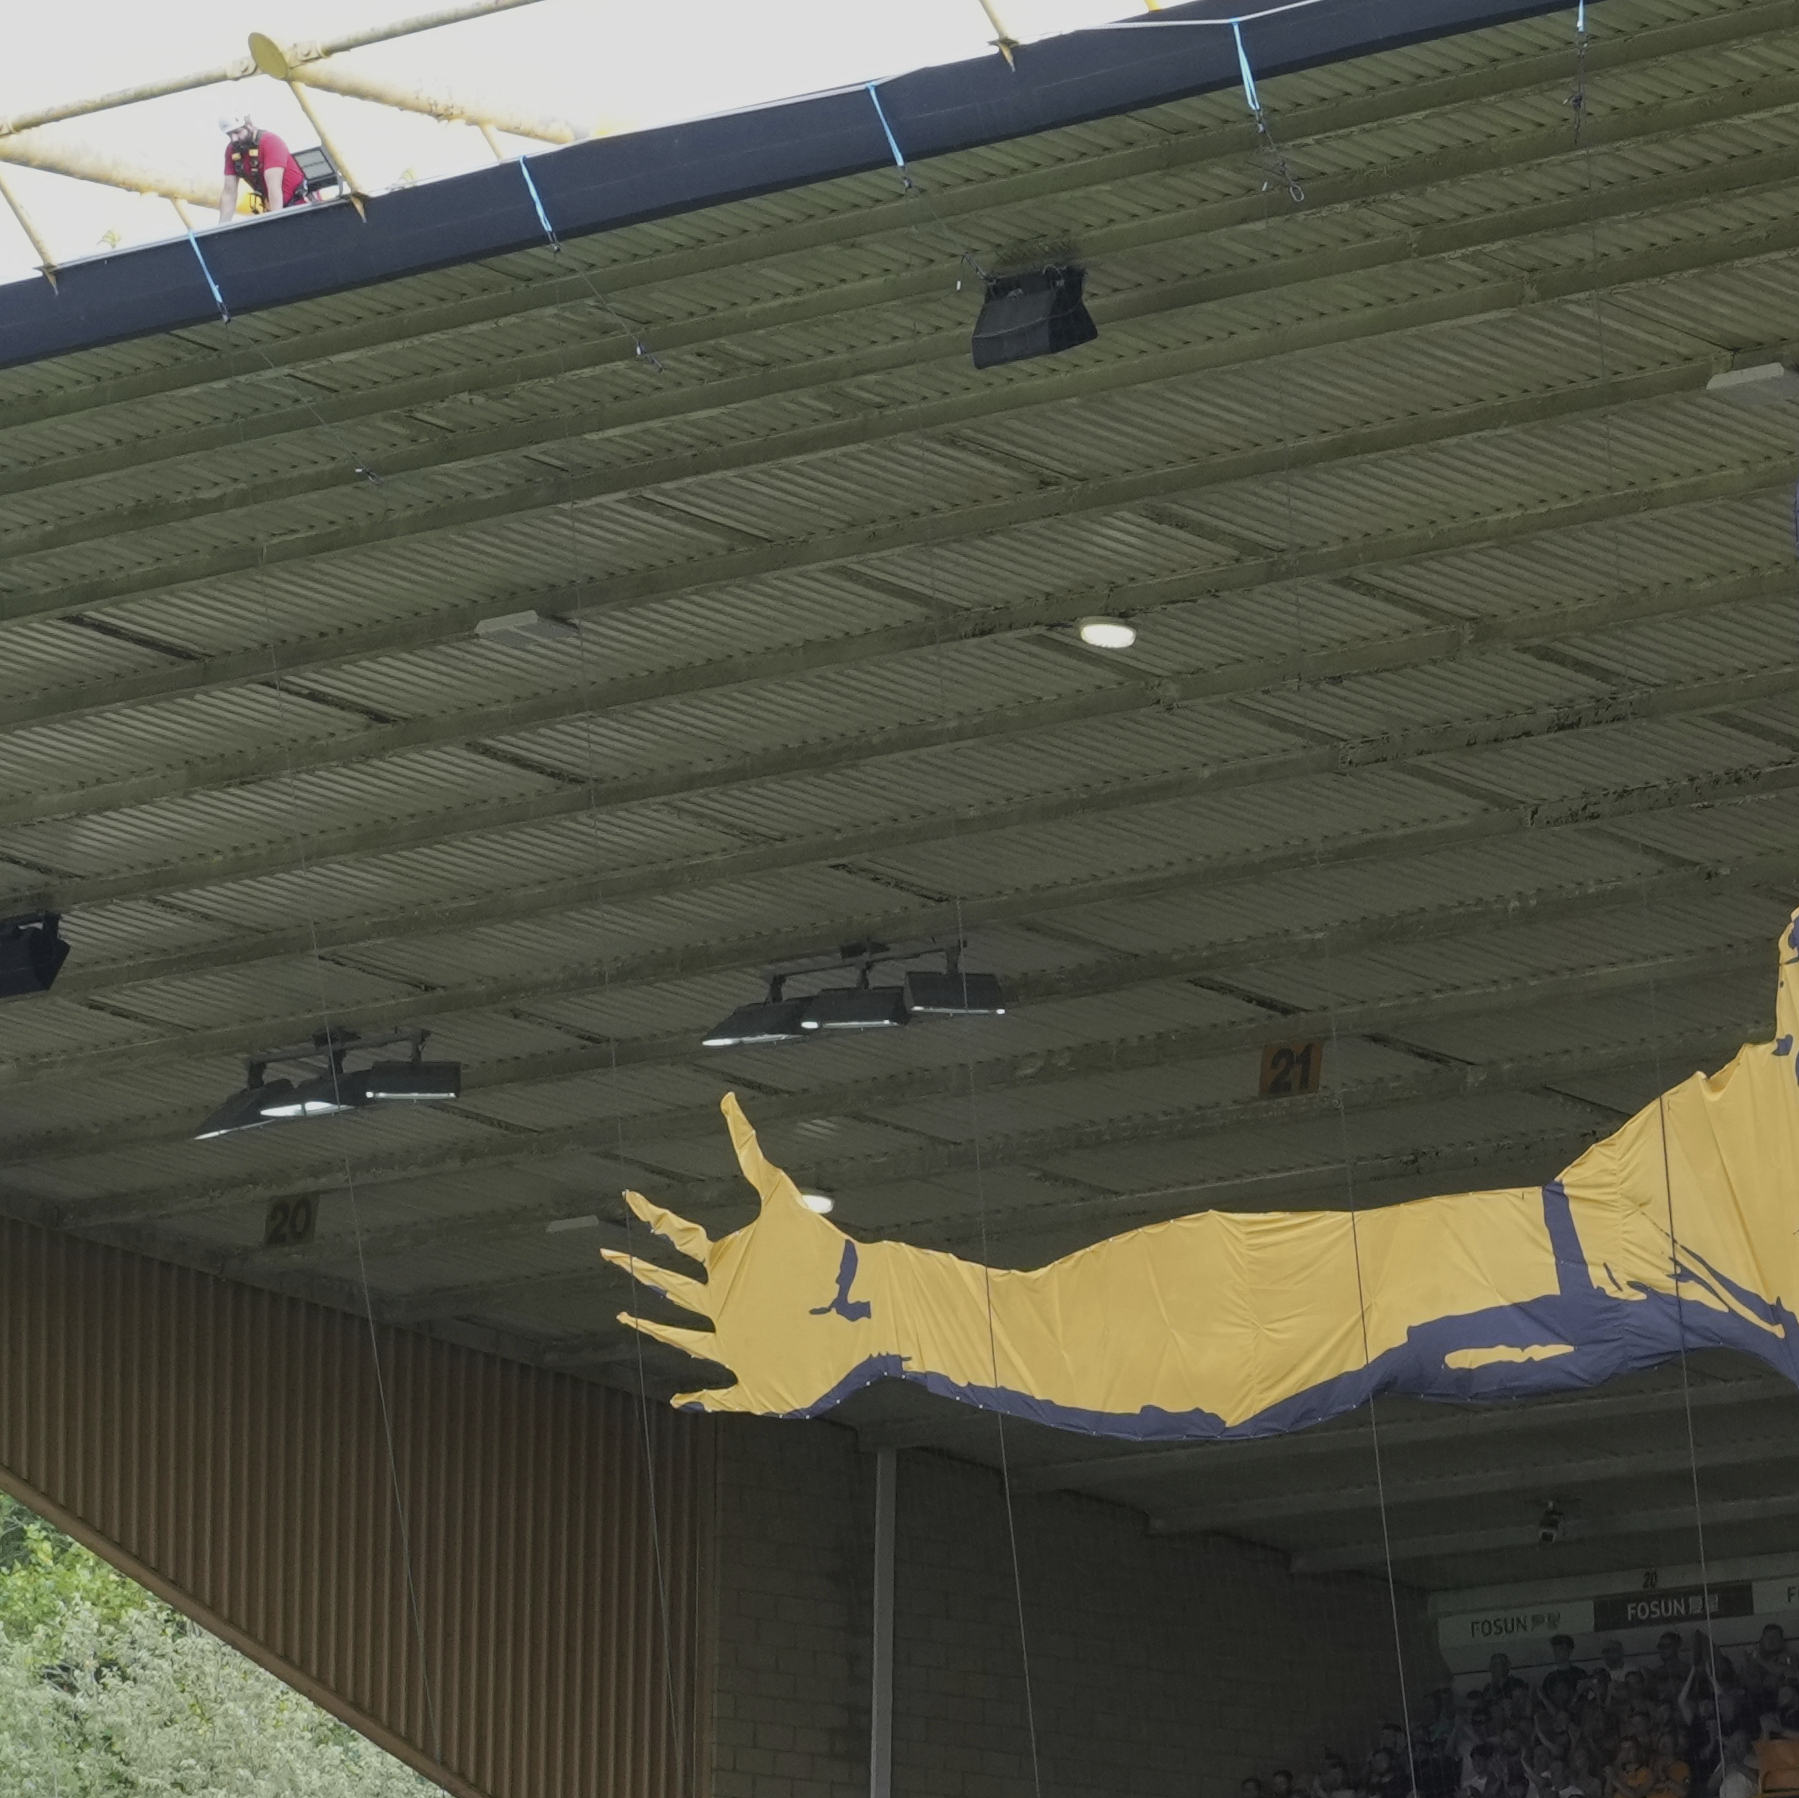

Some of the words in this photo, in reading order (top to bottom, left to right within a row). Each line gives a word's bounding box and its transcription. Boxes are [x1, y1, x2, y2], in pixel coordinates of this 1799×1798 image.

[1269, 1043, 1315, 1094] 21
[268, 1197, 313, 1245] 20
[1642, 1570, 1658, 1589] 20
[1626, 1598, 1685, 1621] FOSUN
[1470, 1616, 1528, 1638] FOSUN
